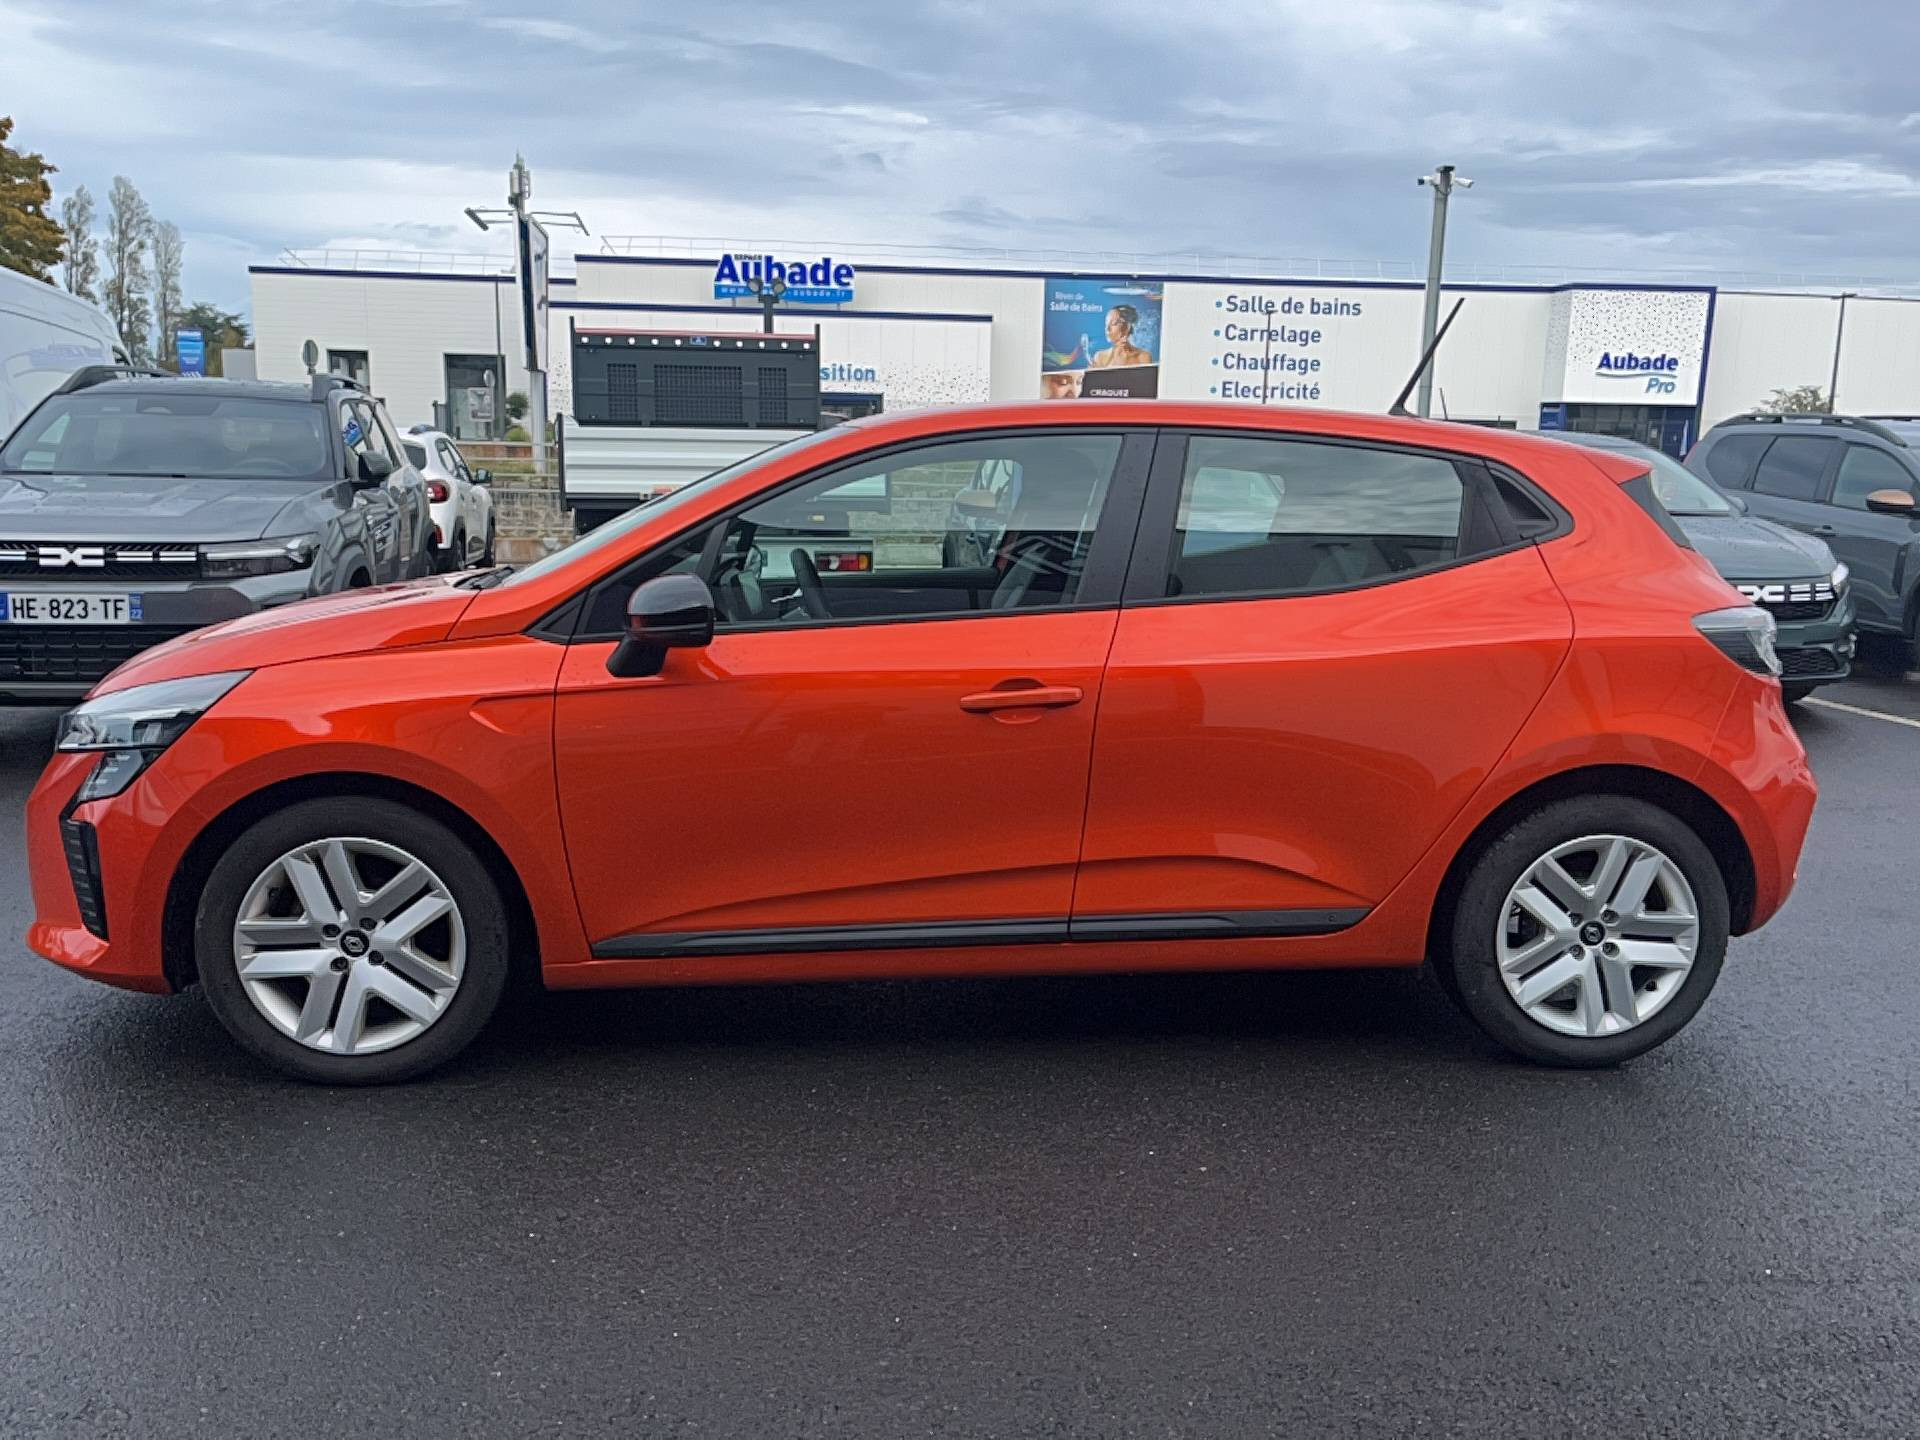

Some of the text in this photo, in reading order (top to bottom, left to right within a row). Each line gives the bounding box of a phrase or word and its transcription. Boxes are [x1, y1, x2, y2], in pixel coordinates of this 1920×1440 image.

[715, 254, 854, 286] Aubade
[1049, 301, 1069, 312] Salle
[1226, 295, 1362, 316] Salle de bains
[1224, 324, 1322, 347] Carrelage
[820, 362, 876, 382] sition
[1222, 353, 1321, 375] Chauffage
[1597, 352, 1679, 371] Aubade
[1645, 377, 1675, 394] Pro
[12, 597, 125, 620] HE-823-TF
